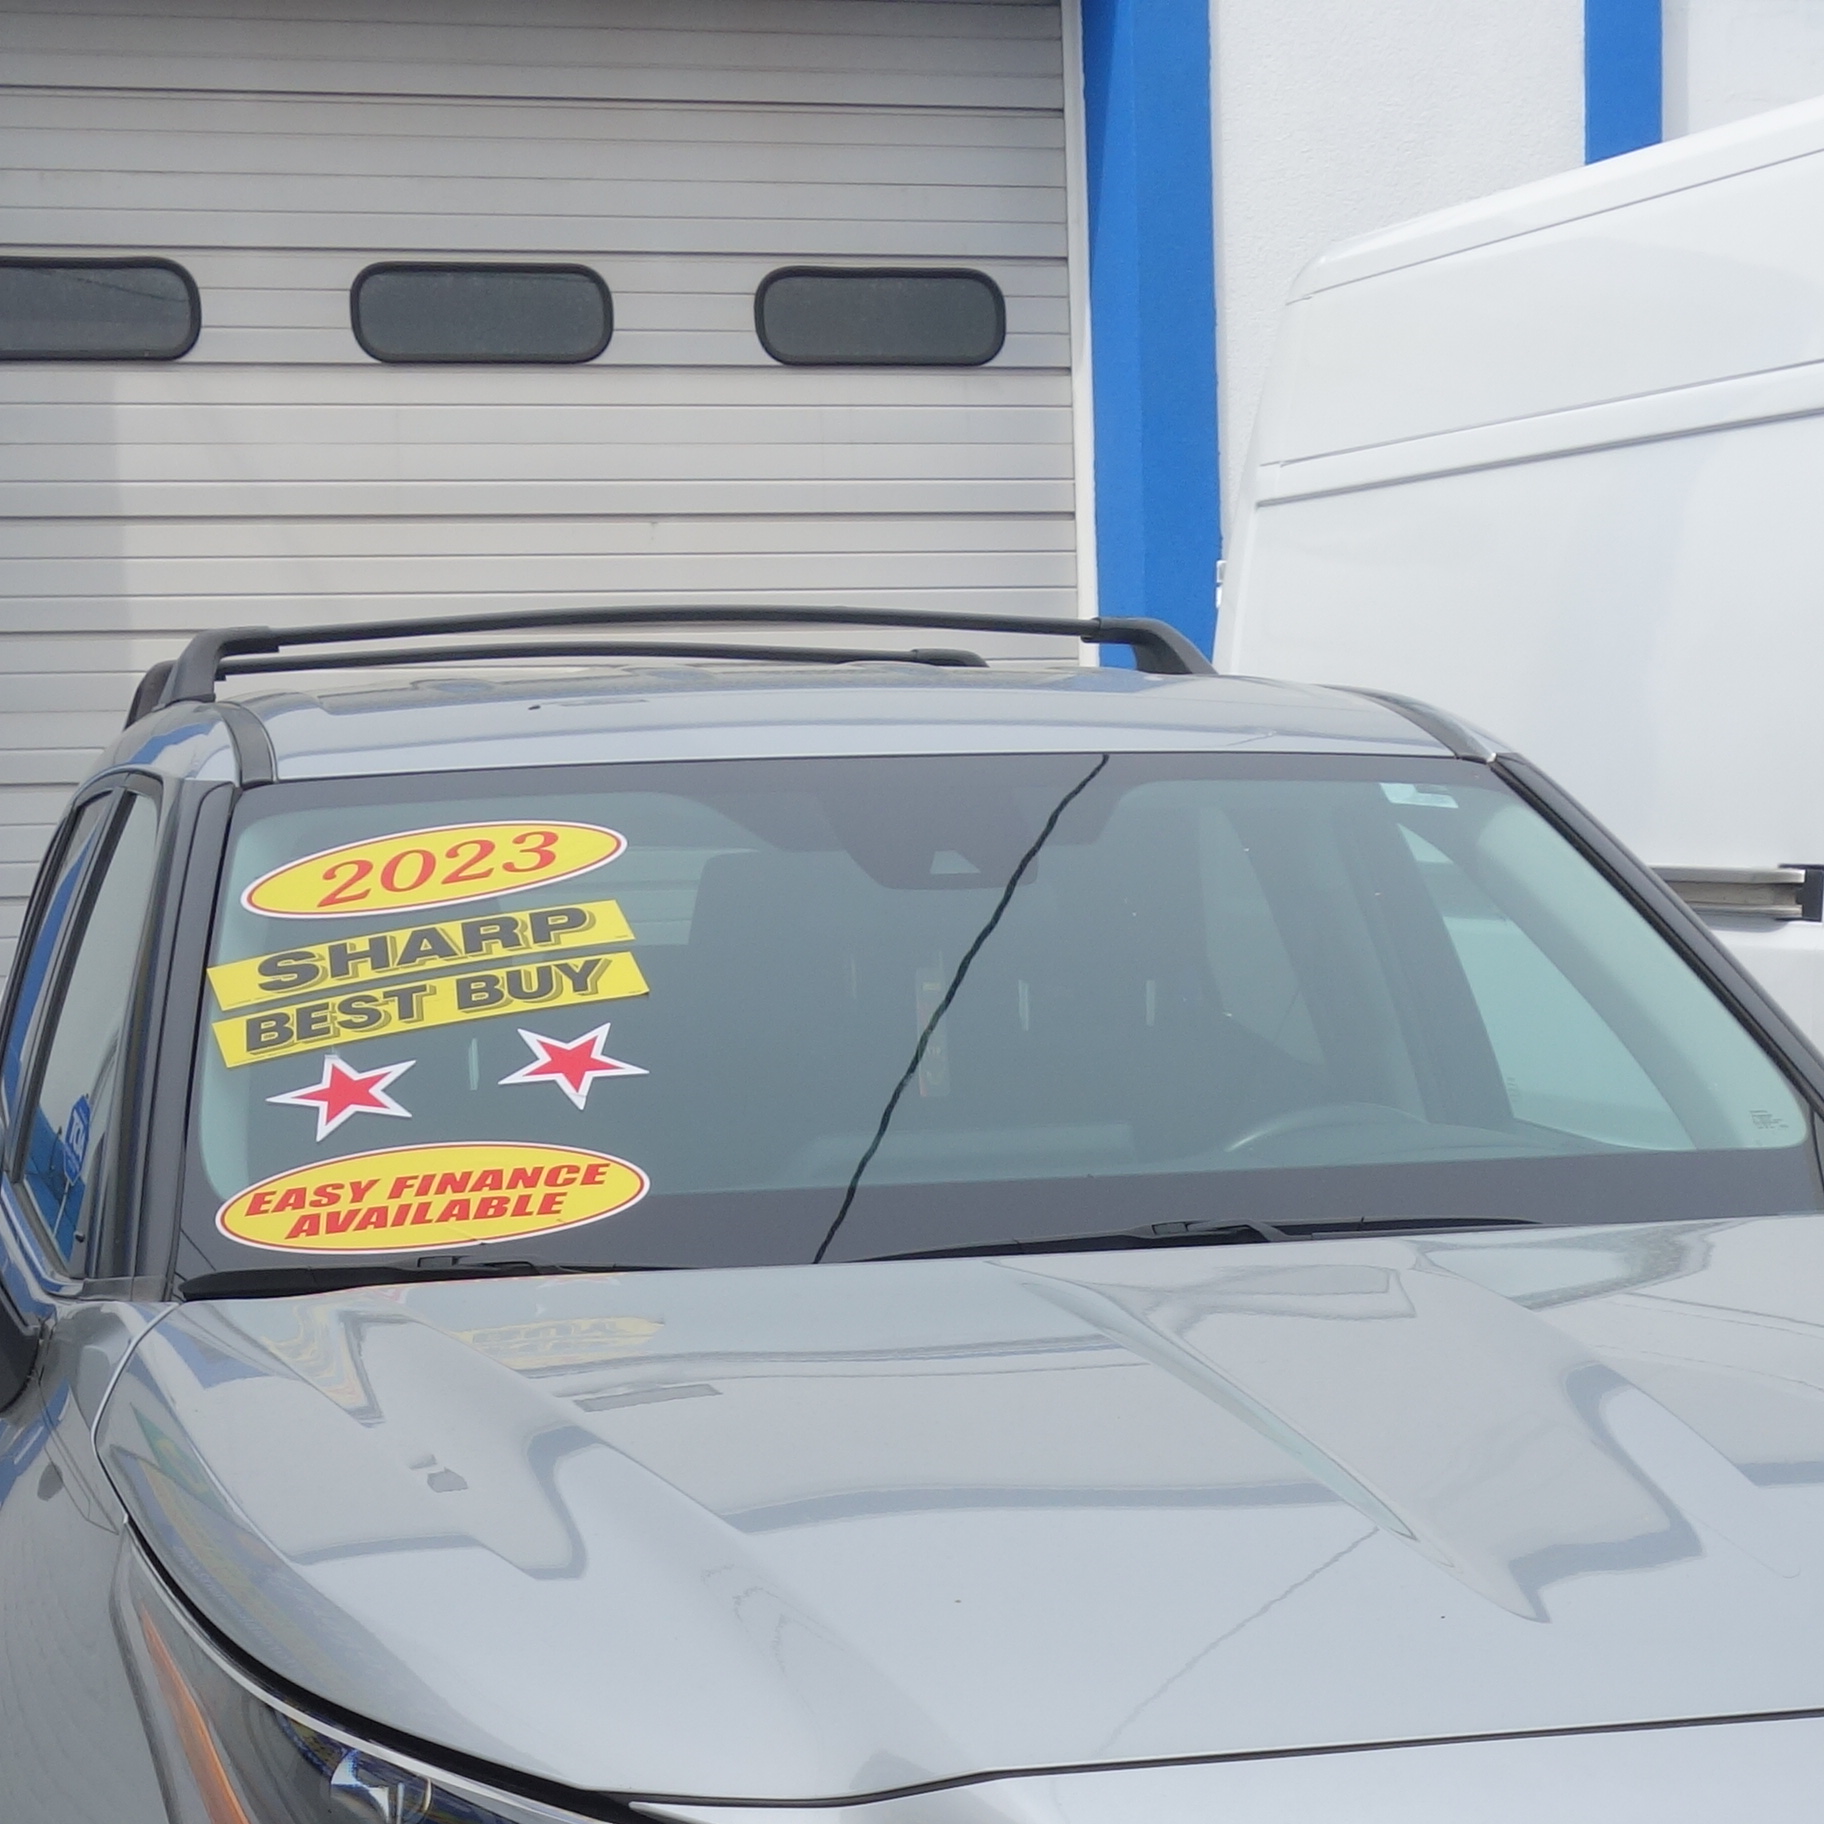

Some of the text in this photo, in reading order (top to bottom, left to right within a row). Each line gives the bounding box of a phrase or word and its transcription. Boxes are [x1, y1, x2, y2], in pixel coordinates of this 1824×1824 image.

[316, 830, 560, 908] 2023
[257, 907, 596, 994] SHARP
[245, 957, 613, 1055] BEST BUY
[244, 1163, 610, 1217] EASY FINANCE
[284, 1192, 568, 1240] AVAILABLE
